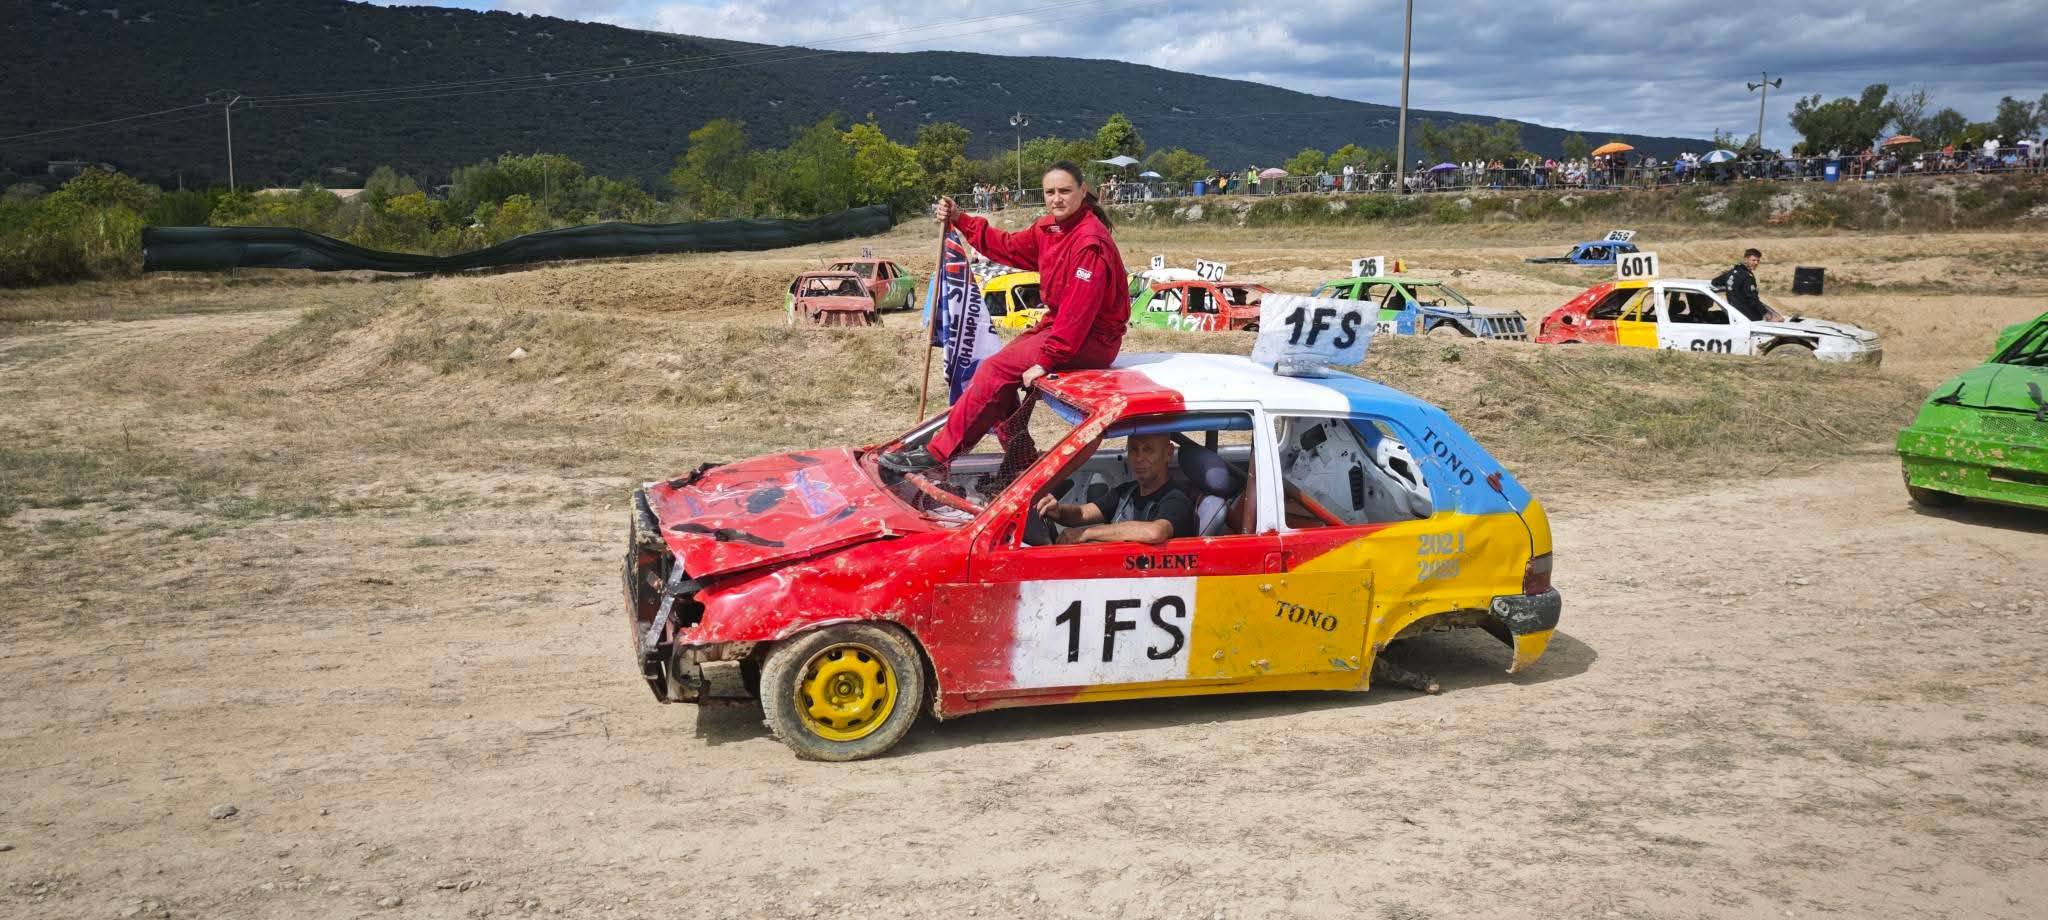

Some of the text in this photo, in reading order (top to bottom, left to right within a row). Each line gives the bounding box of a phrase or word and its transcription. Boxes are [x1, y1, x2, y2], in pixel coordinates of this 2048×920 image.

[1197, 261, 1224, 281] 270
[1359, 258, 1377, 277] 26
[1621, 256, 1653, 277] 601
[1284, 306, 1362, 349] 1FS
[1422, 425, 1475, 488] TONO
[1125, 554, 1199, 570] SOLENE
[1054, 595, 1187, 664] 1FS
[1275, 600, 1338, 633] TONO
